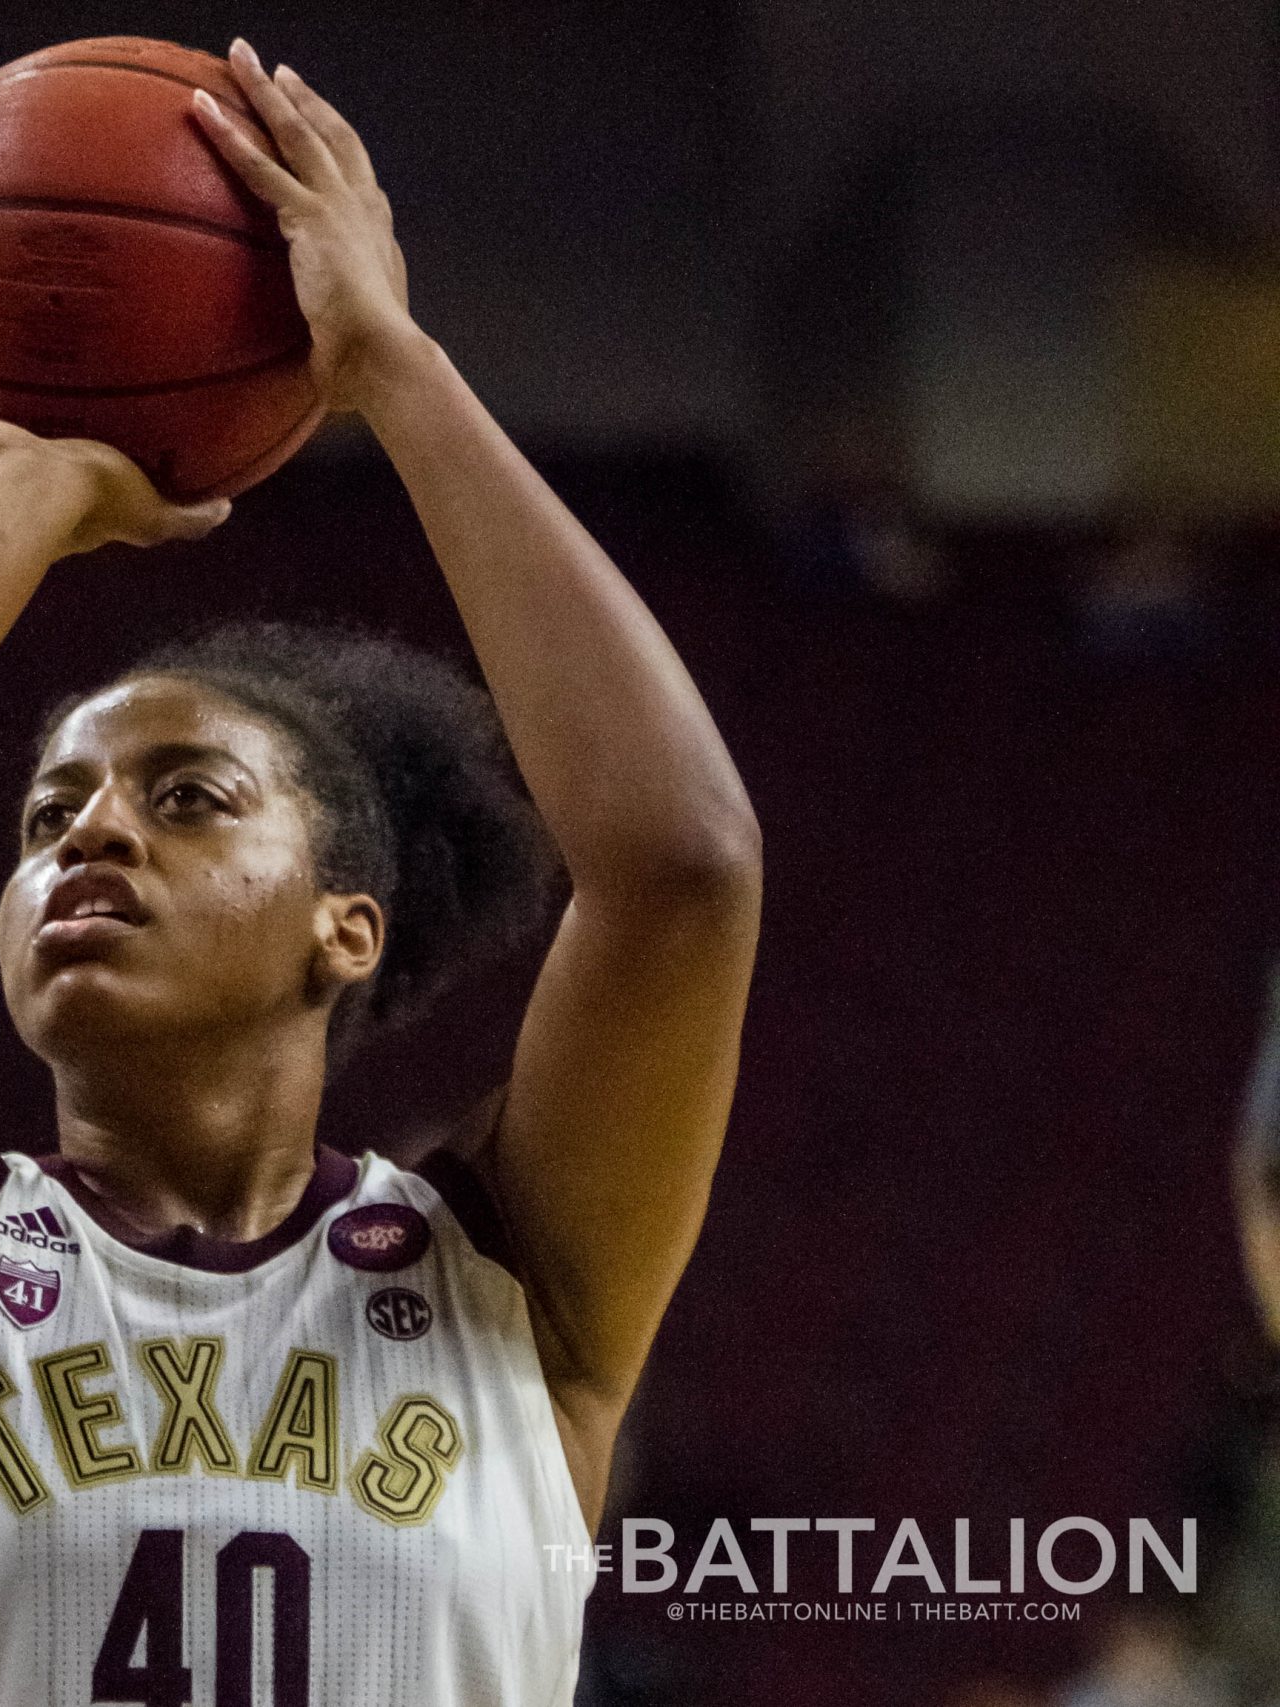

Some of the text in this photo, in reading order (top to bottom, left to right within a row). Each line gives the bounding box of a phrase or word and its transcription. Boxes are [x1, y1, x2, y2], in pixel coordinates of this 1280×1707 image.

[2, 1281, 48, 1314] 41
[373, 1295, 427, 1336] SEC
[91, 1529, 311, 1707] 40
